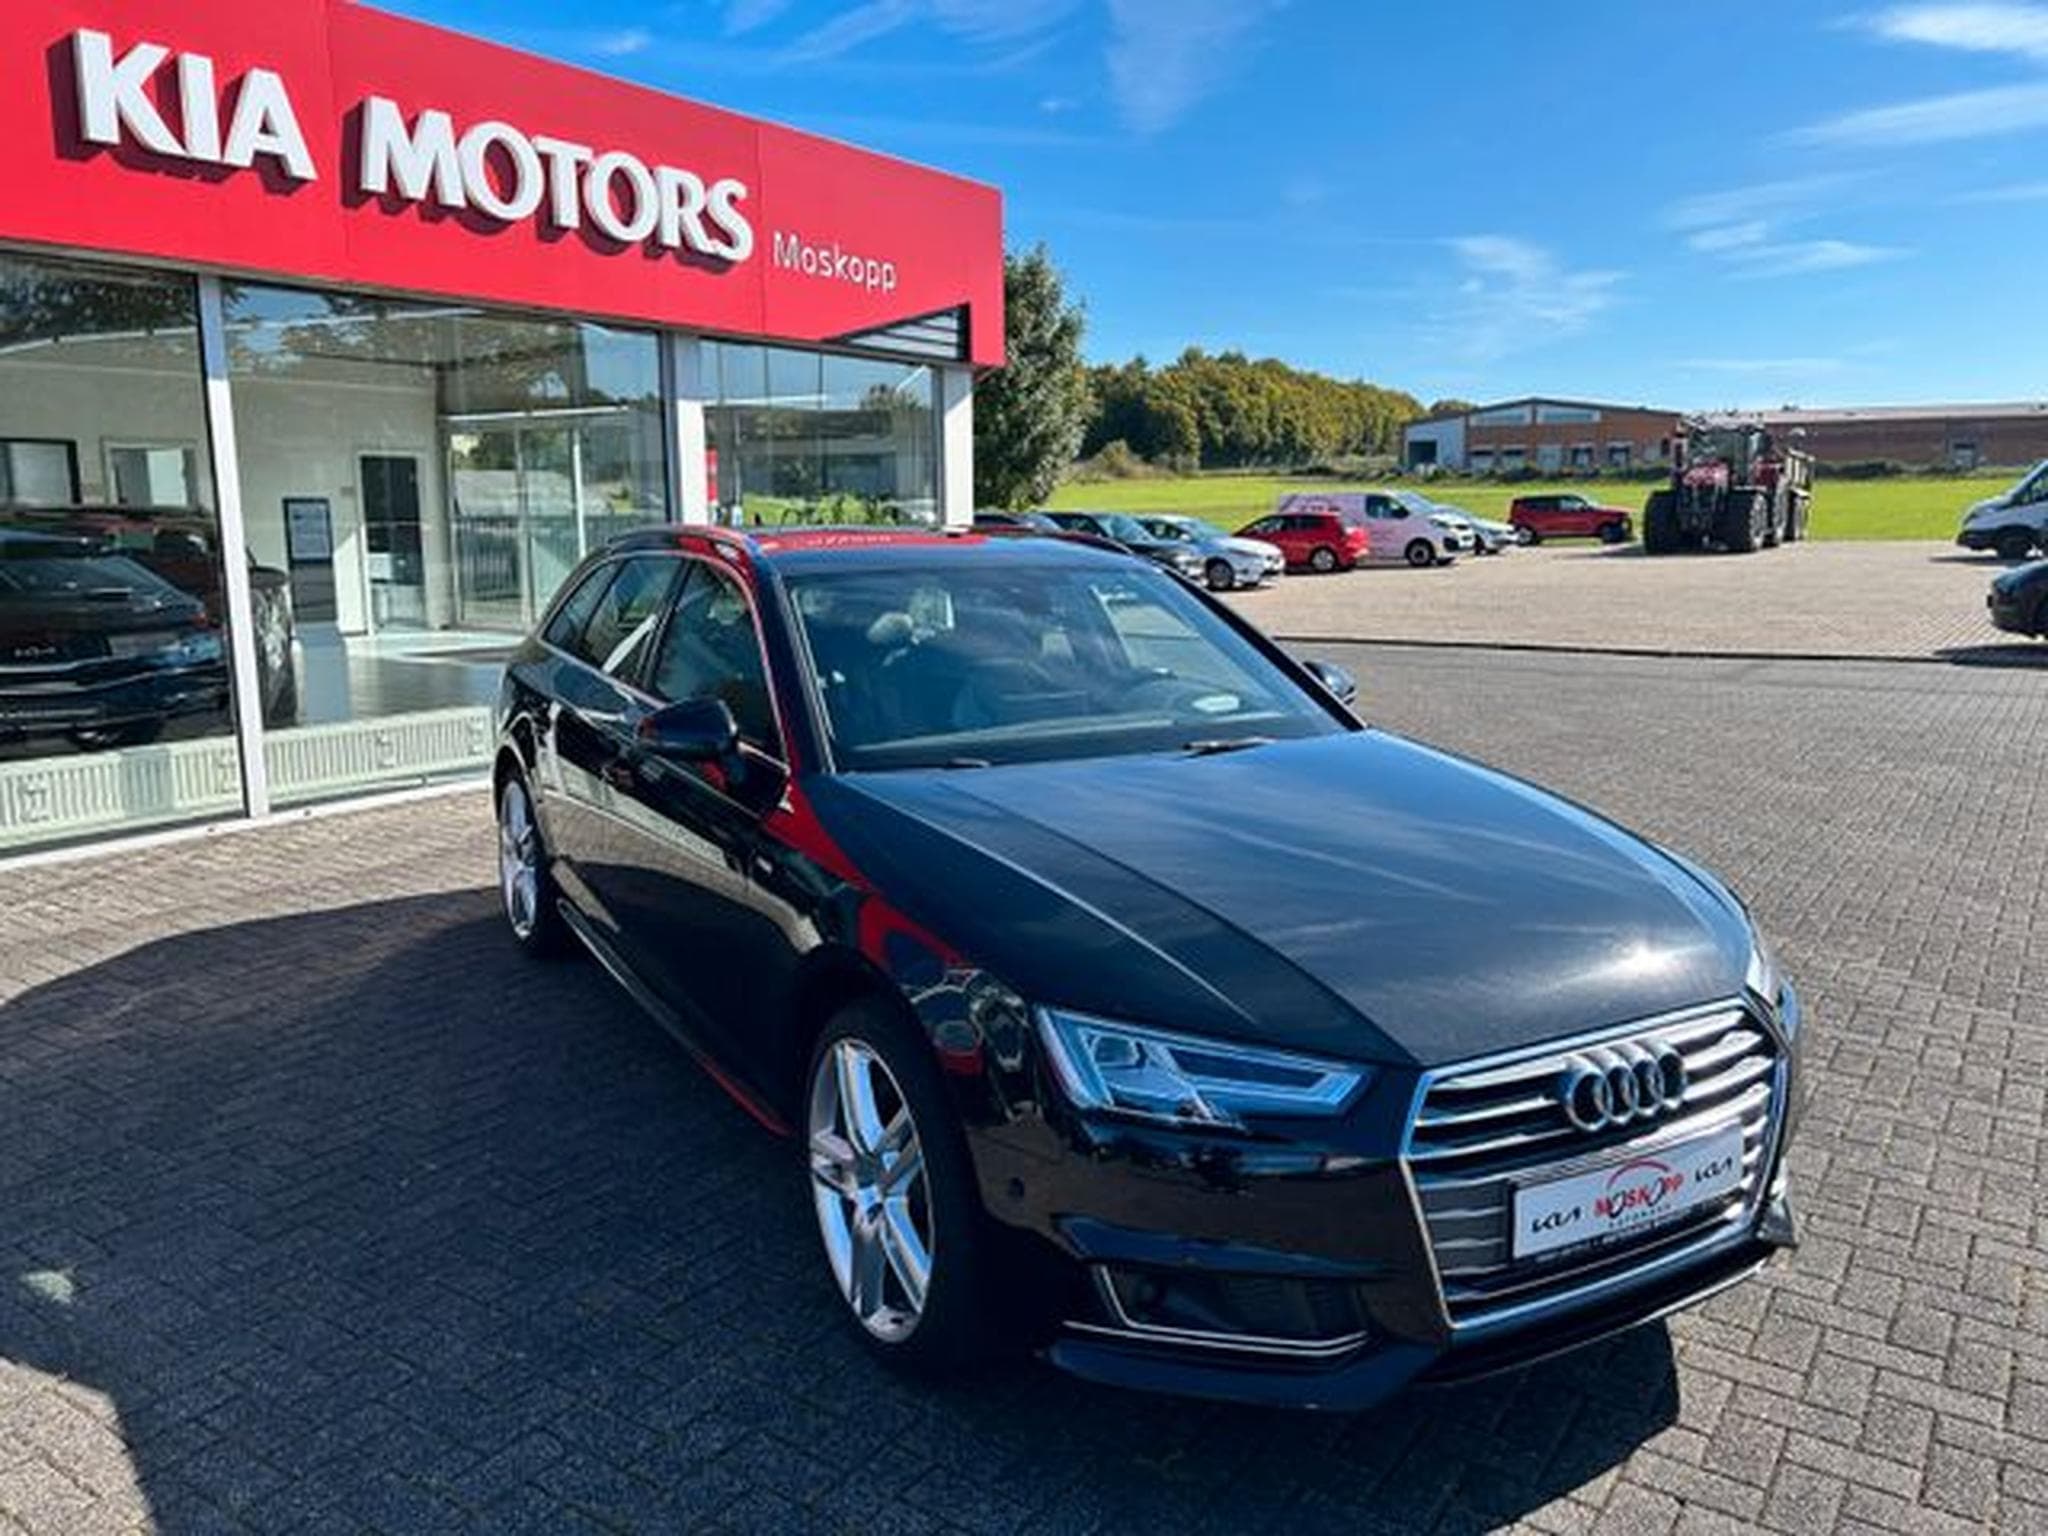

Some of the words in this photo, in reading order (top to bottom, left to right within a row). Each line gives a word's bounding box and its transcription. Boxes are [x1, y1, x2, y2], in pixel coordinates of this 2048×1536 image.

[74, 27, 318, 181] KIA
[360, 95, 754, 262] MOTORS
[773, 230, 897, 294] Moskopp
